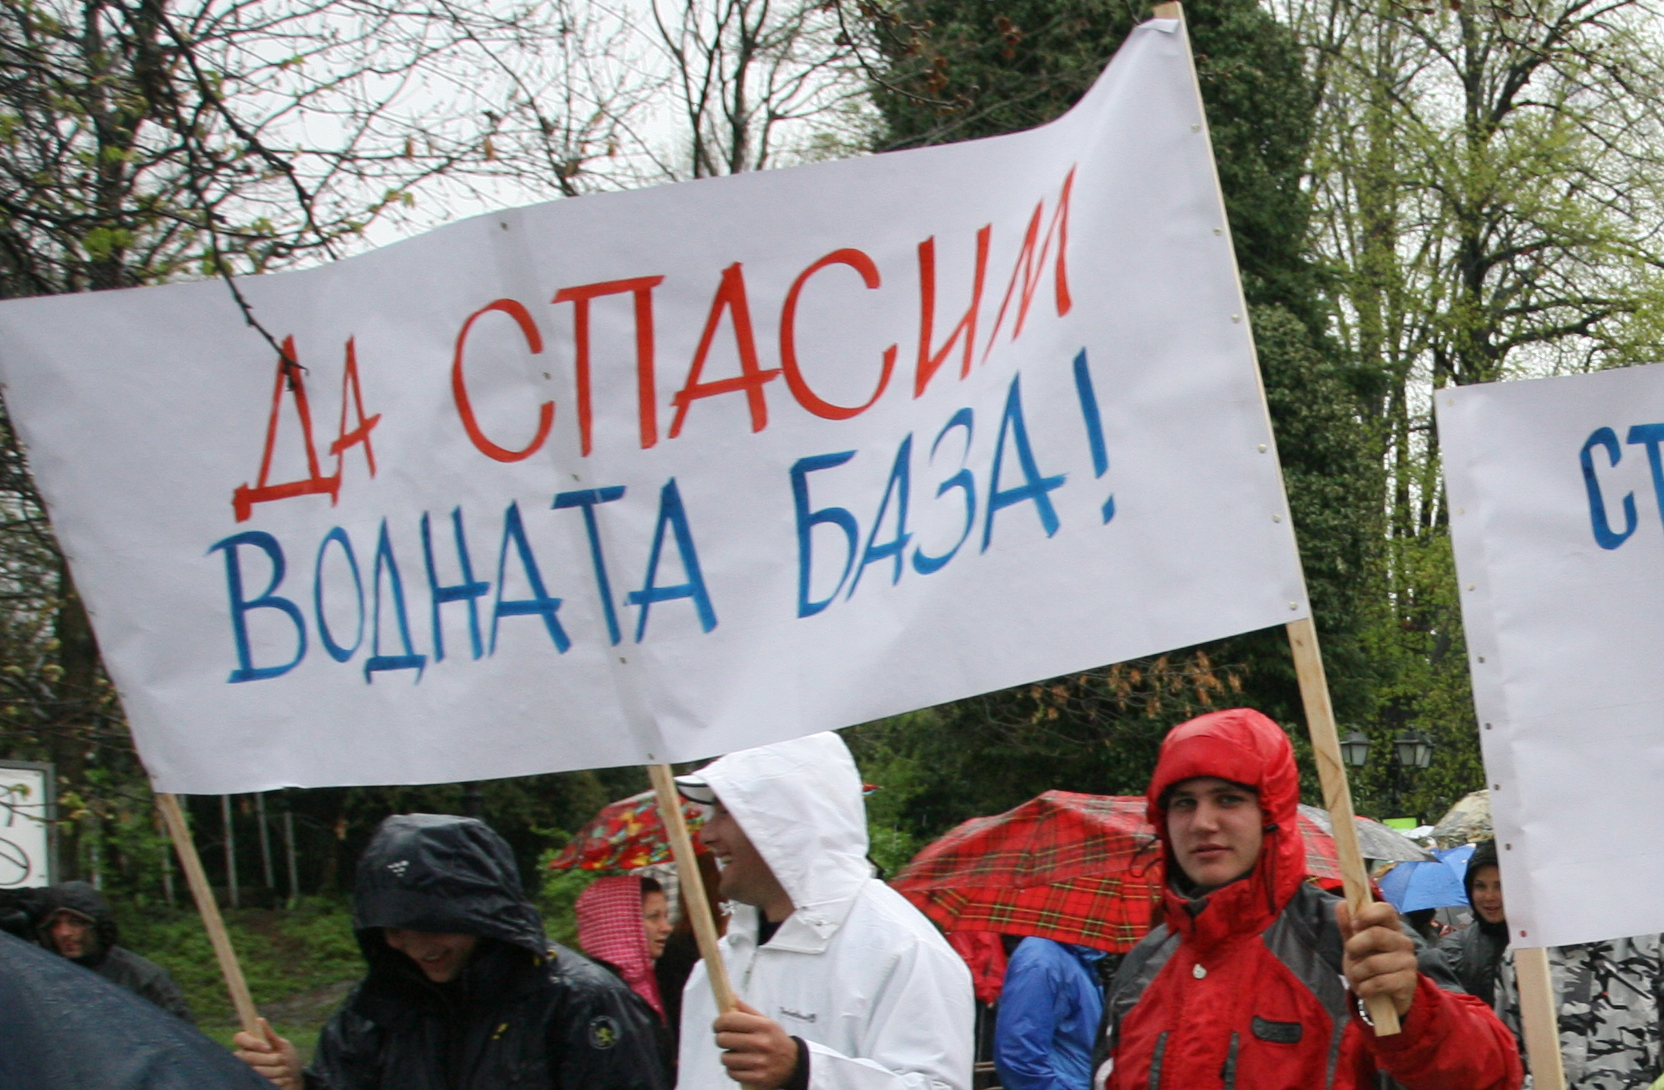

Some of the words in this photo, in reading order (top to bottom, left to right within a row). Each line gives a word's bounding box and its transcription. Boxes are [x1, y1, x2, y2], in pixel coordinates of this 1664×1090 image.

[206, 477, 718, 686] ВОДНАТА
[789, 345, 1118, 619] БАЗА!
[231, 334, 382, 523] ДА
[451, 162, 1078, 463] СПАСИМ
